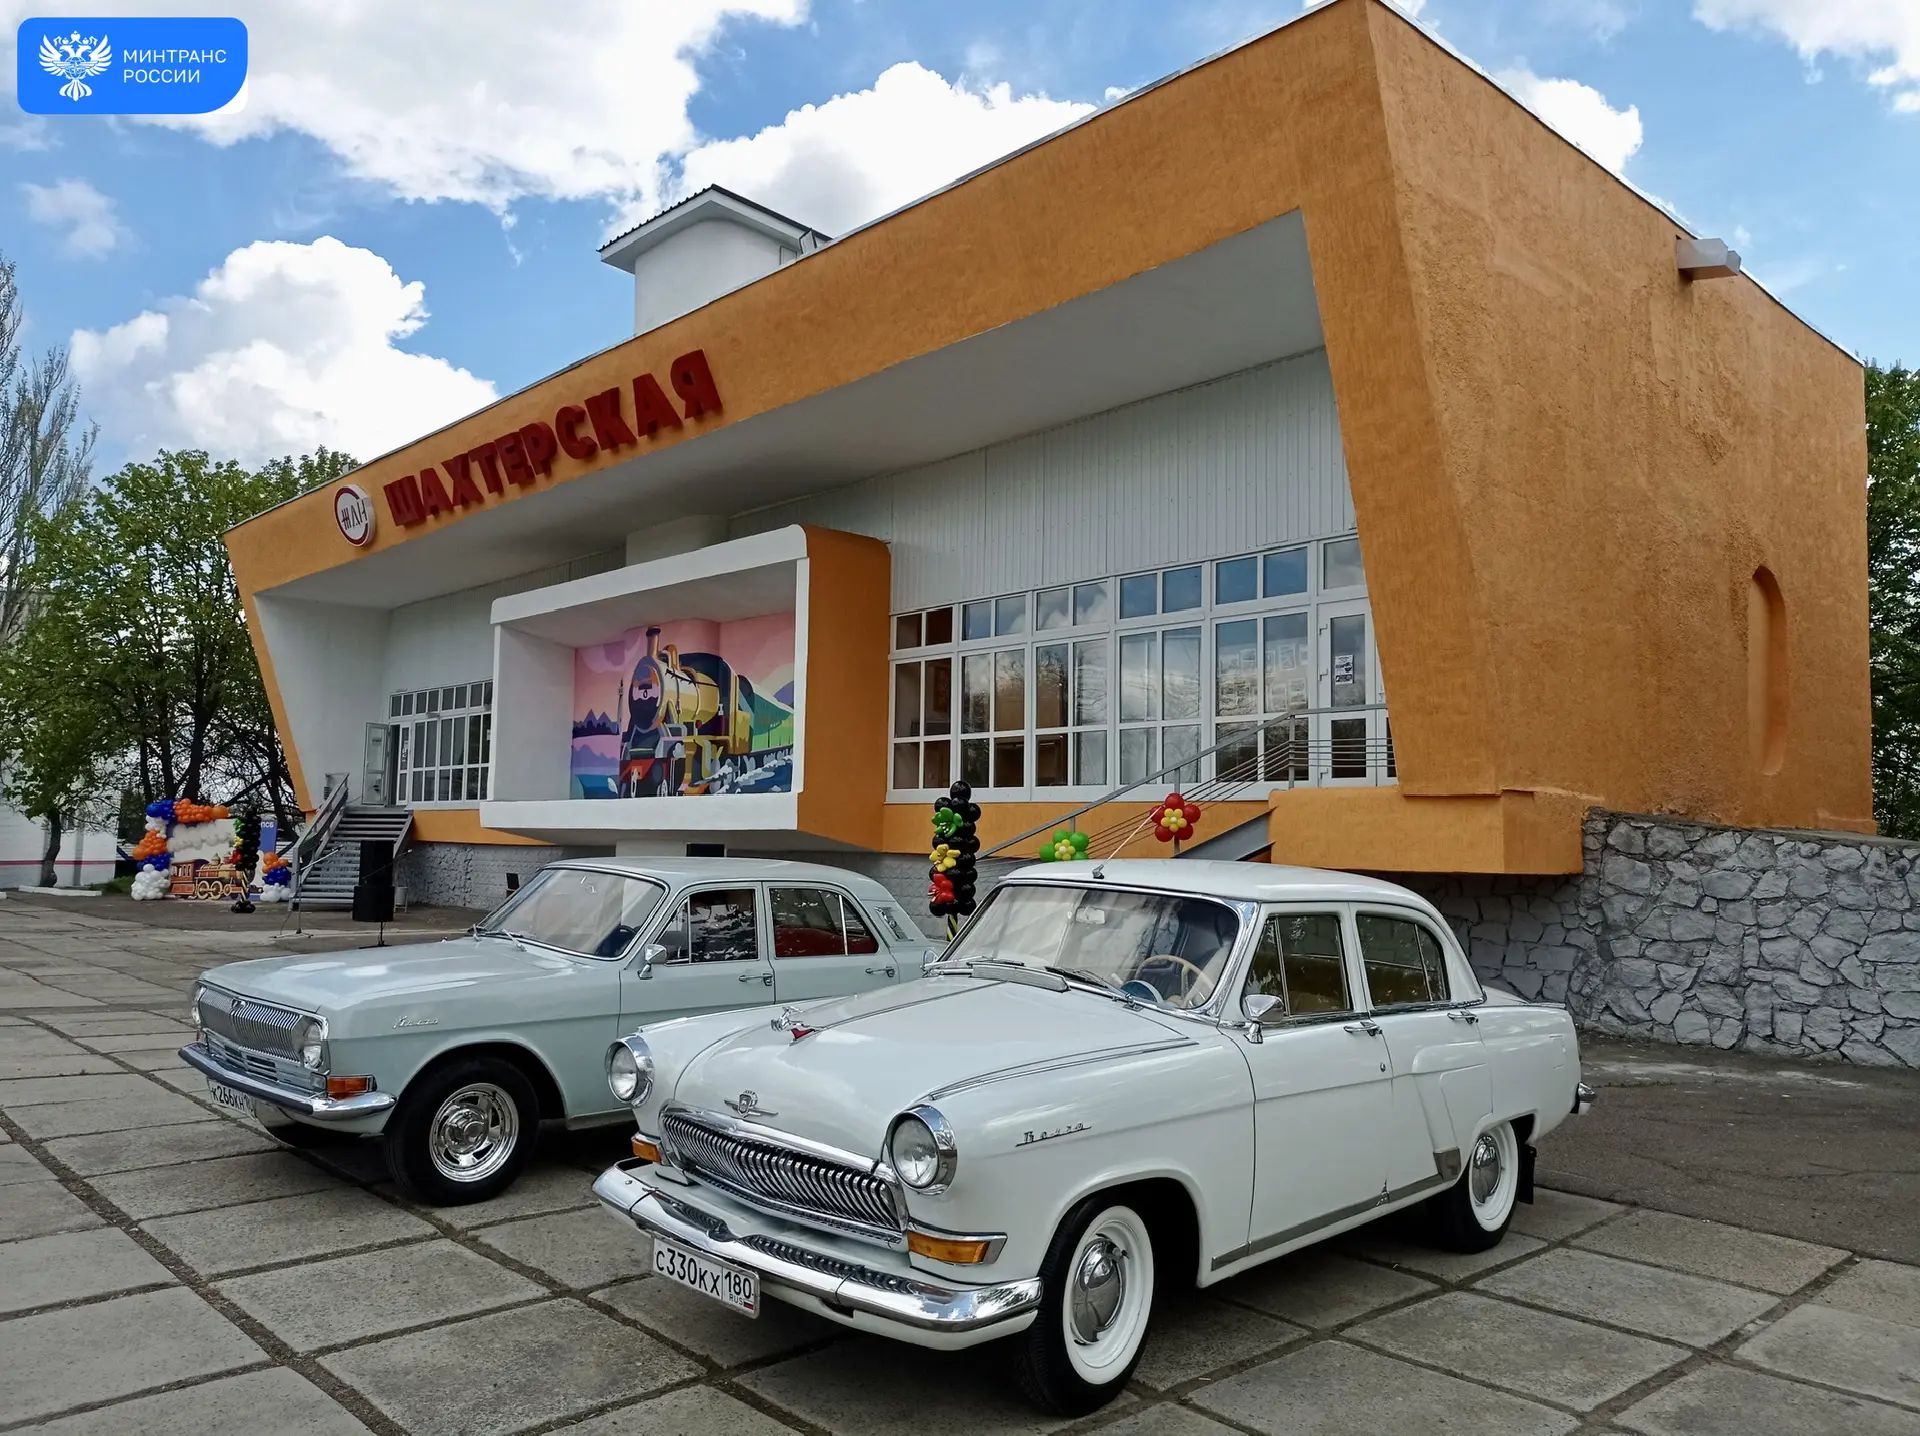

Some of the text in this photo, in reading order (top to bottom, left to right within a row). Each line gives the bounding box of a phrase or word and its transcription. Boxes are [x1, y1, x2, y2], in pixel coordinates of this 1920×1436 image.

[383, 349, 722, 527] ШАХТЕРСКАЯ
[656, 1248, 751, 1299] С330КХ 180
[729, 1293, 743, 1306] RUS
